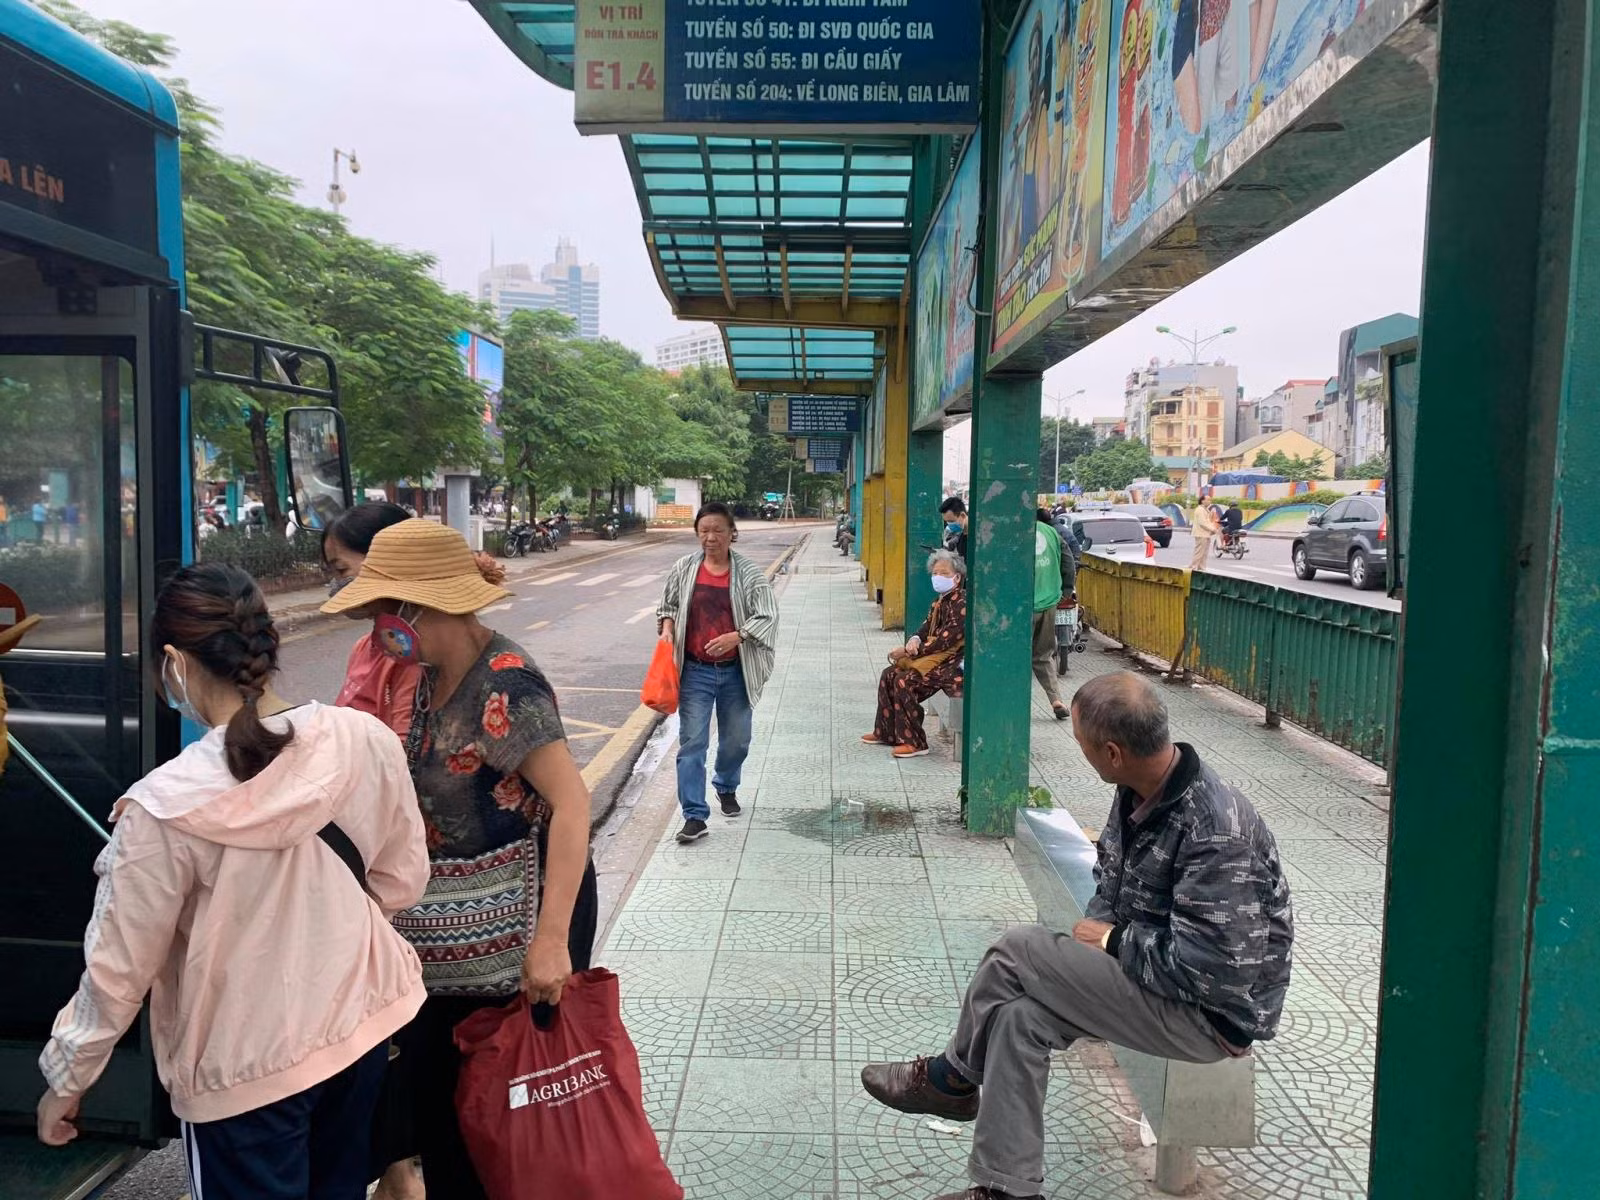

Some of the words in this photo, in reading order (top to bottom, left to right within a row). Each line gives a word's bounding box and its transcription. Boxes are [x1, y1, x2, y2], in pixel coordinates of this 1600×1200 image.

[600, 5, 614, 23] VỊ
[619, 3, 643, 20] TRÍ
[685, 15, 737, 38] TUYẾN
[742, 15, 765, 38] SỐ
[768, 21, 793, 39] 50:
[798, 21, 815, 39] ĐI
[820, 21, 852, 39] SVĐ
[857, 15, 901, 40] QUỐC
[906, 22, 934, 39] GIA
[684, 46, 738, 69] TUYẾN
[743, 46, 767, 69] SỐ
[770, 52, 796, 69] 55:
[801, 52, 819, 69] ĐI
[824, 46, 858, 69] CẦU
[863, 46, 902, 70] GIẤY
[586, 61, 657, 91] E1.4
[684, 77, 731, 100] TUYẾN
[736, 77, 757, 100] SỐ
[760, 84, 792, 101] 204:
[796, 78, 816, 101] VỀ
[819, 84, 858, 101] LONG
[863, 81, 903, 104] BIÊN,
[907, 85, 933, 102] GIA
[937, 82, 970, 102] LÂM
[20, 164, 65, 203] LÊN
[530, 1064, 608, 1104] AGRIBANK
